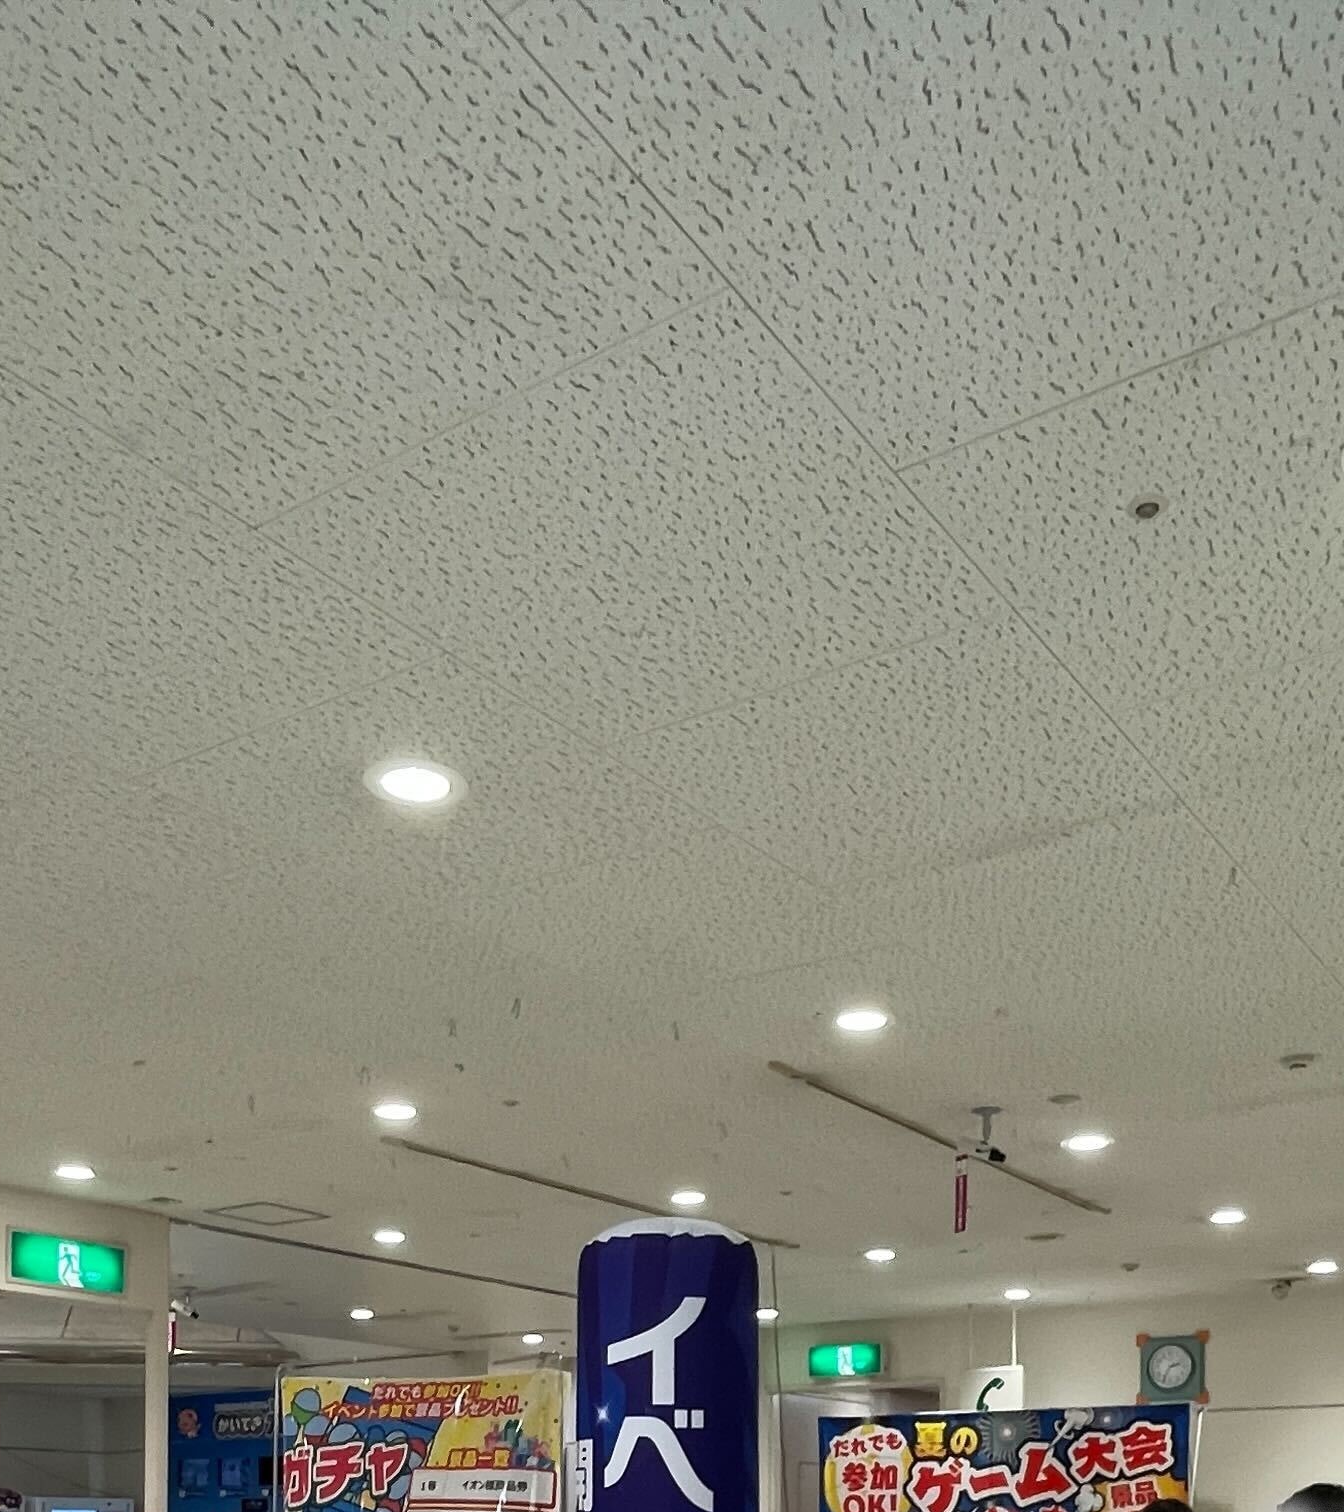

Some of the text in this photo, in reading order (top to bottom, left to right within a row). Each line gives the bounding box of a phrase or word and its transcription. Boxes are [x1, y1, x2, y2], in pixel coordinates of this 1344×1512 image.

[833, 1432, 903, 1458] だれでも
[915, 1422, 978, 1457] 夏の
[283, 1443, 408, 1508] ガチャ
[842, 1461, 898, 1492] 参加
